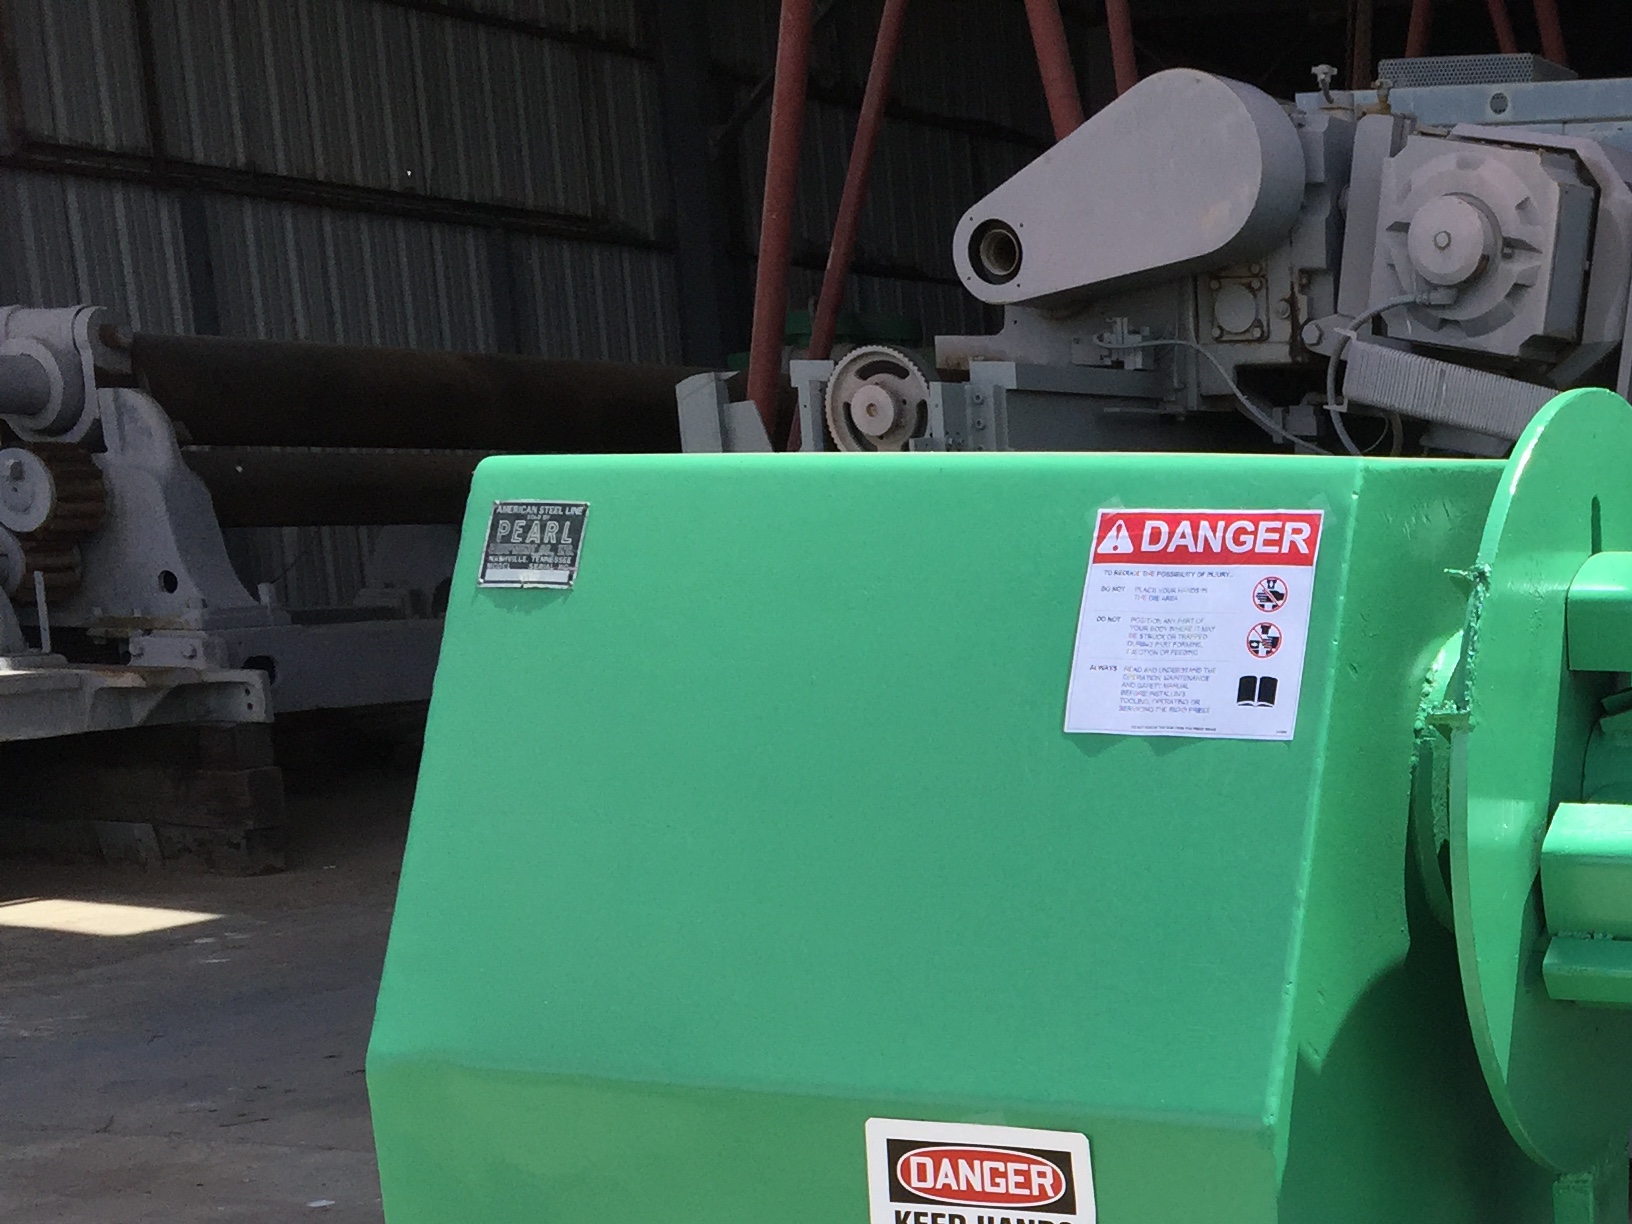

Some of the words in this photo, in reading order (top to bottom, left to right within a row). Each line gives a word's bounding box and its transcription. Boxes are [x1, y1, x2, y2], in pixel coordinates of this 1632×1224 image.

[495, 505, 537, 514] AMERICAN
[539, 506, 563, 515] STEEL
[565, 507, 584, 515] LINE
[496, 520, 572, 543] PEARL
[1140, 520, 1312, 554] DANGER
[531, 555, 572, 564] TENNESSEE
[909, 1156, 1055, 1197] DANGER
